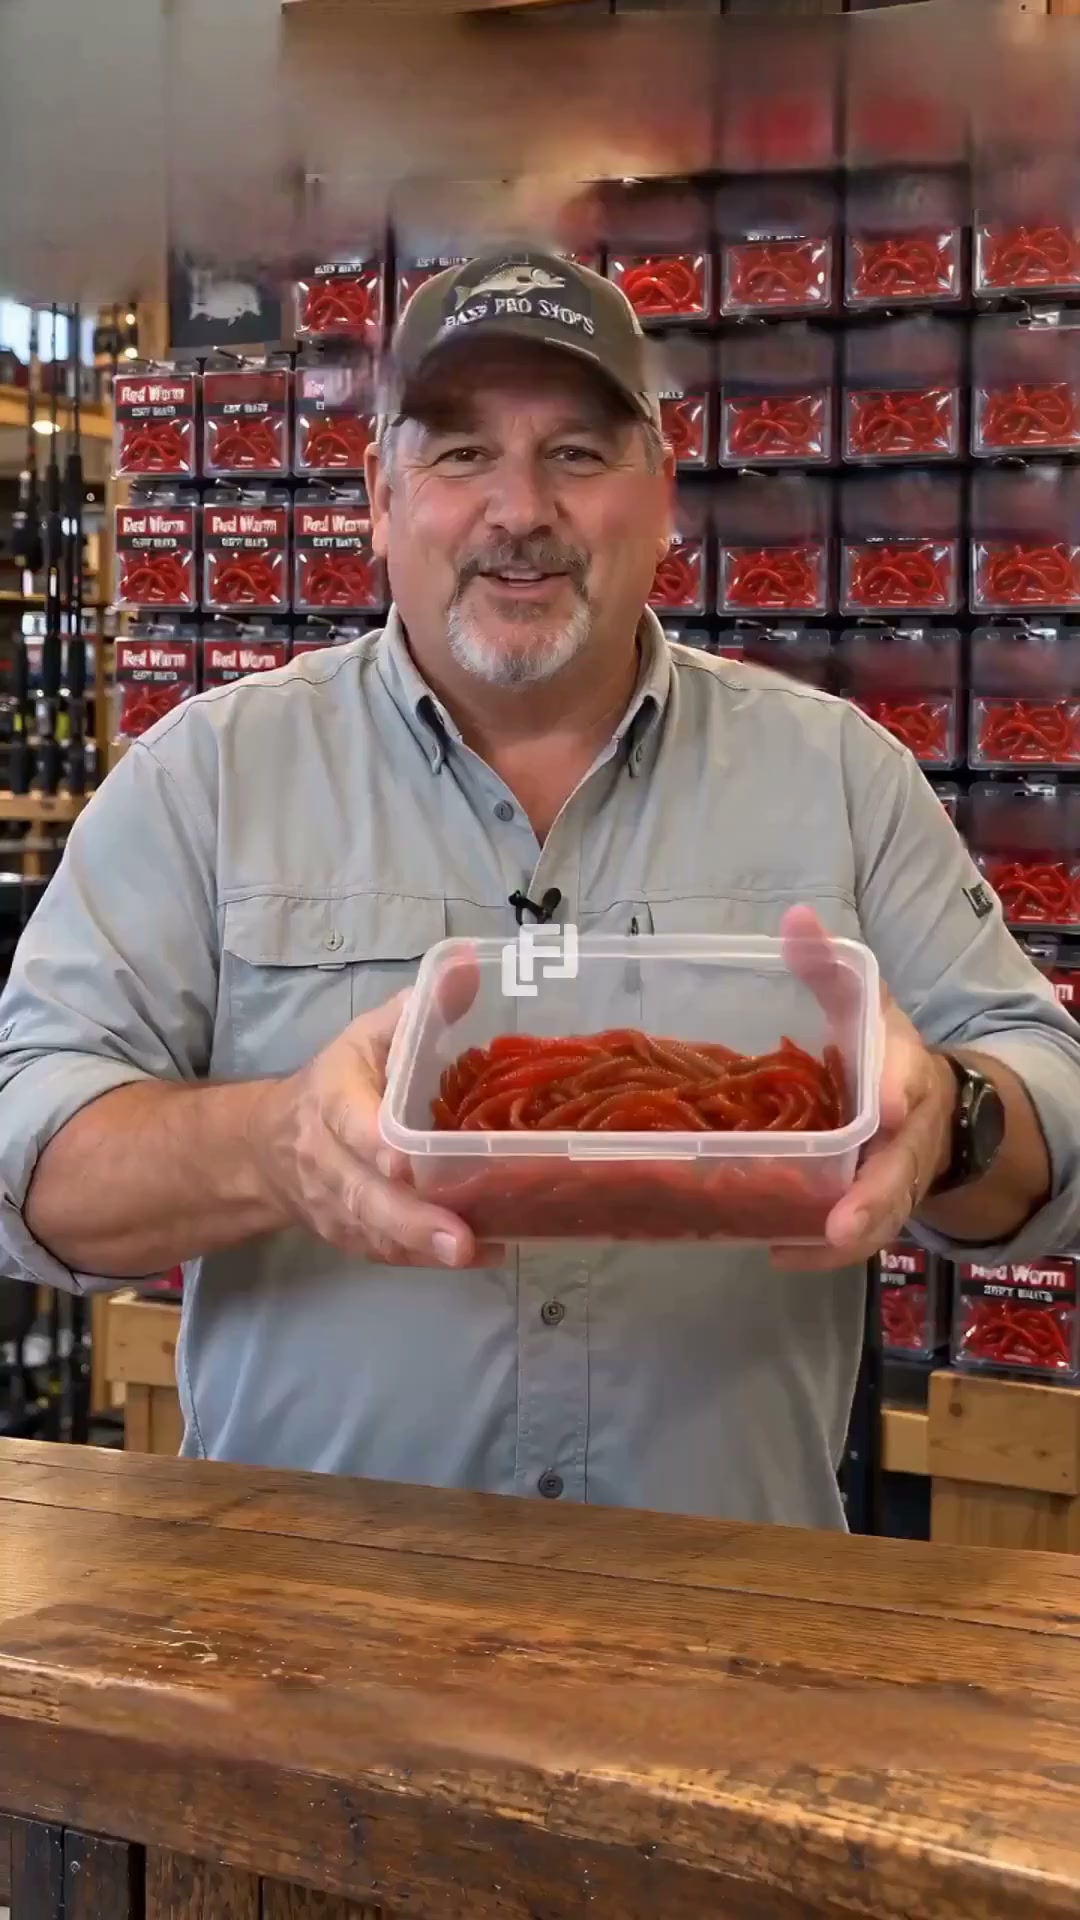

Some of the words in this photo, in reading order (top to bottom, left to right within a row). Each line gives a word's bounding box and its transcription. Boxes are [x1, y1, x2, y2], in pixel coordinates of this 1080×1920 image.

[494, 298, 532, 316] PRO
[212, 516, 236, 533] Red
[239, 515, 277, 533] Worm
[303, 515, 329, 533] Red
[1011, 1264, 1066, 1287] Worm
